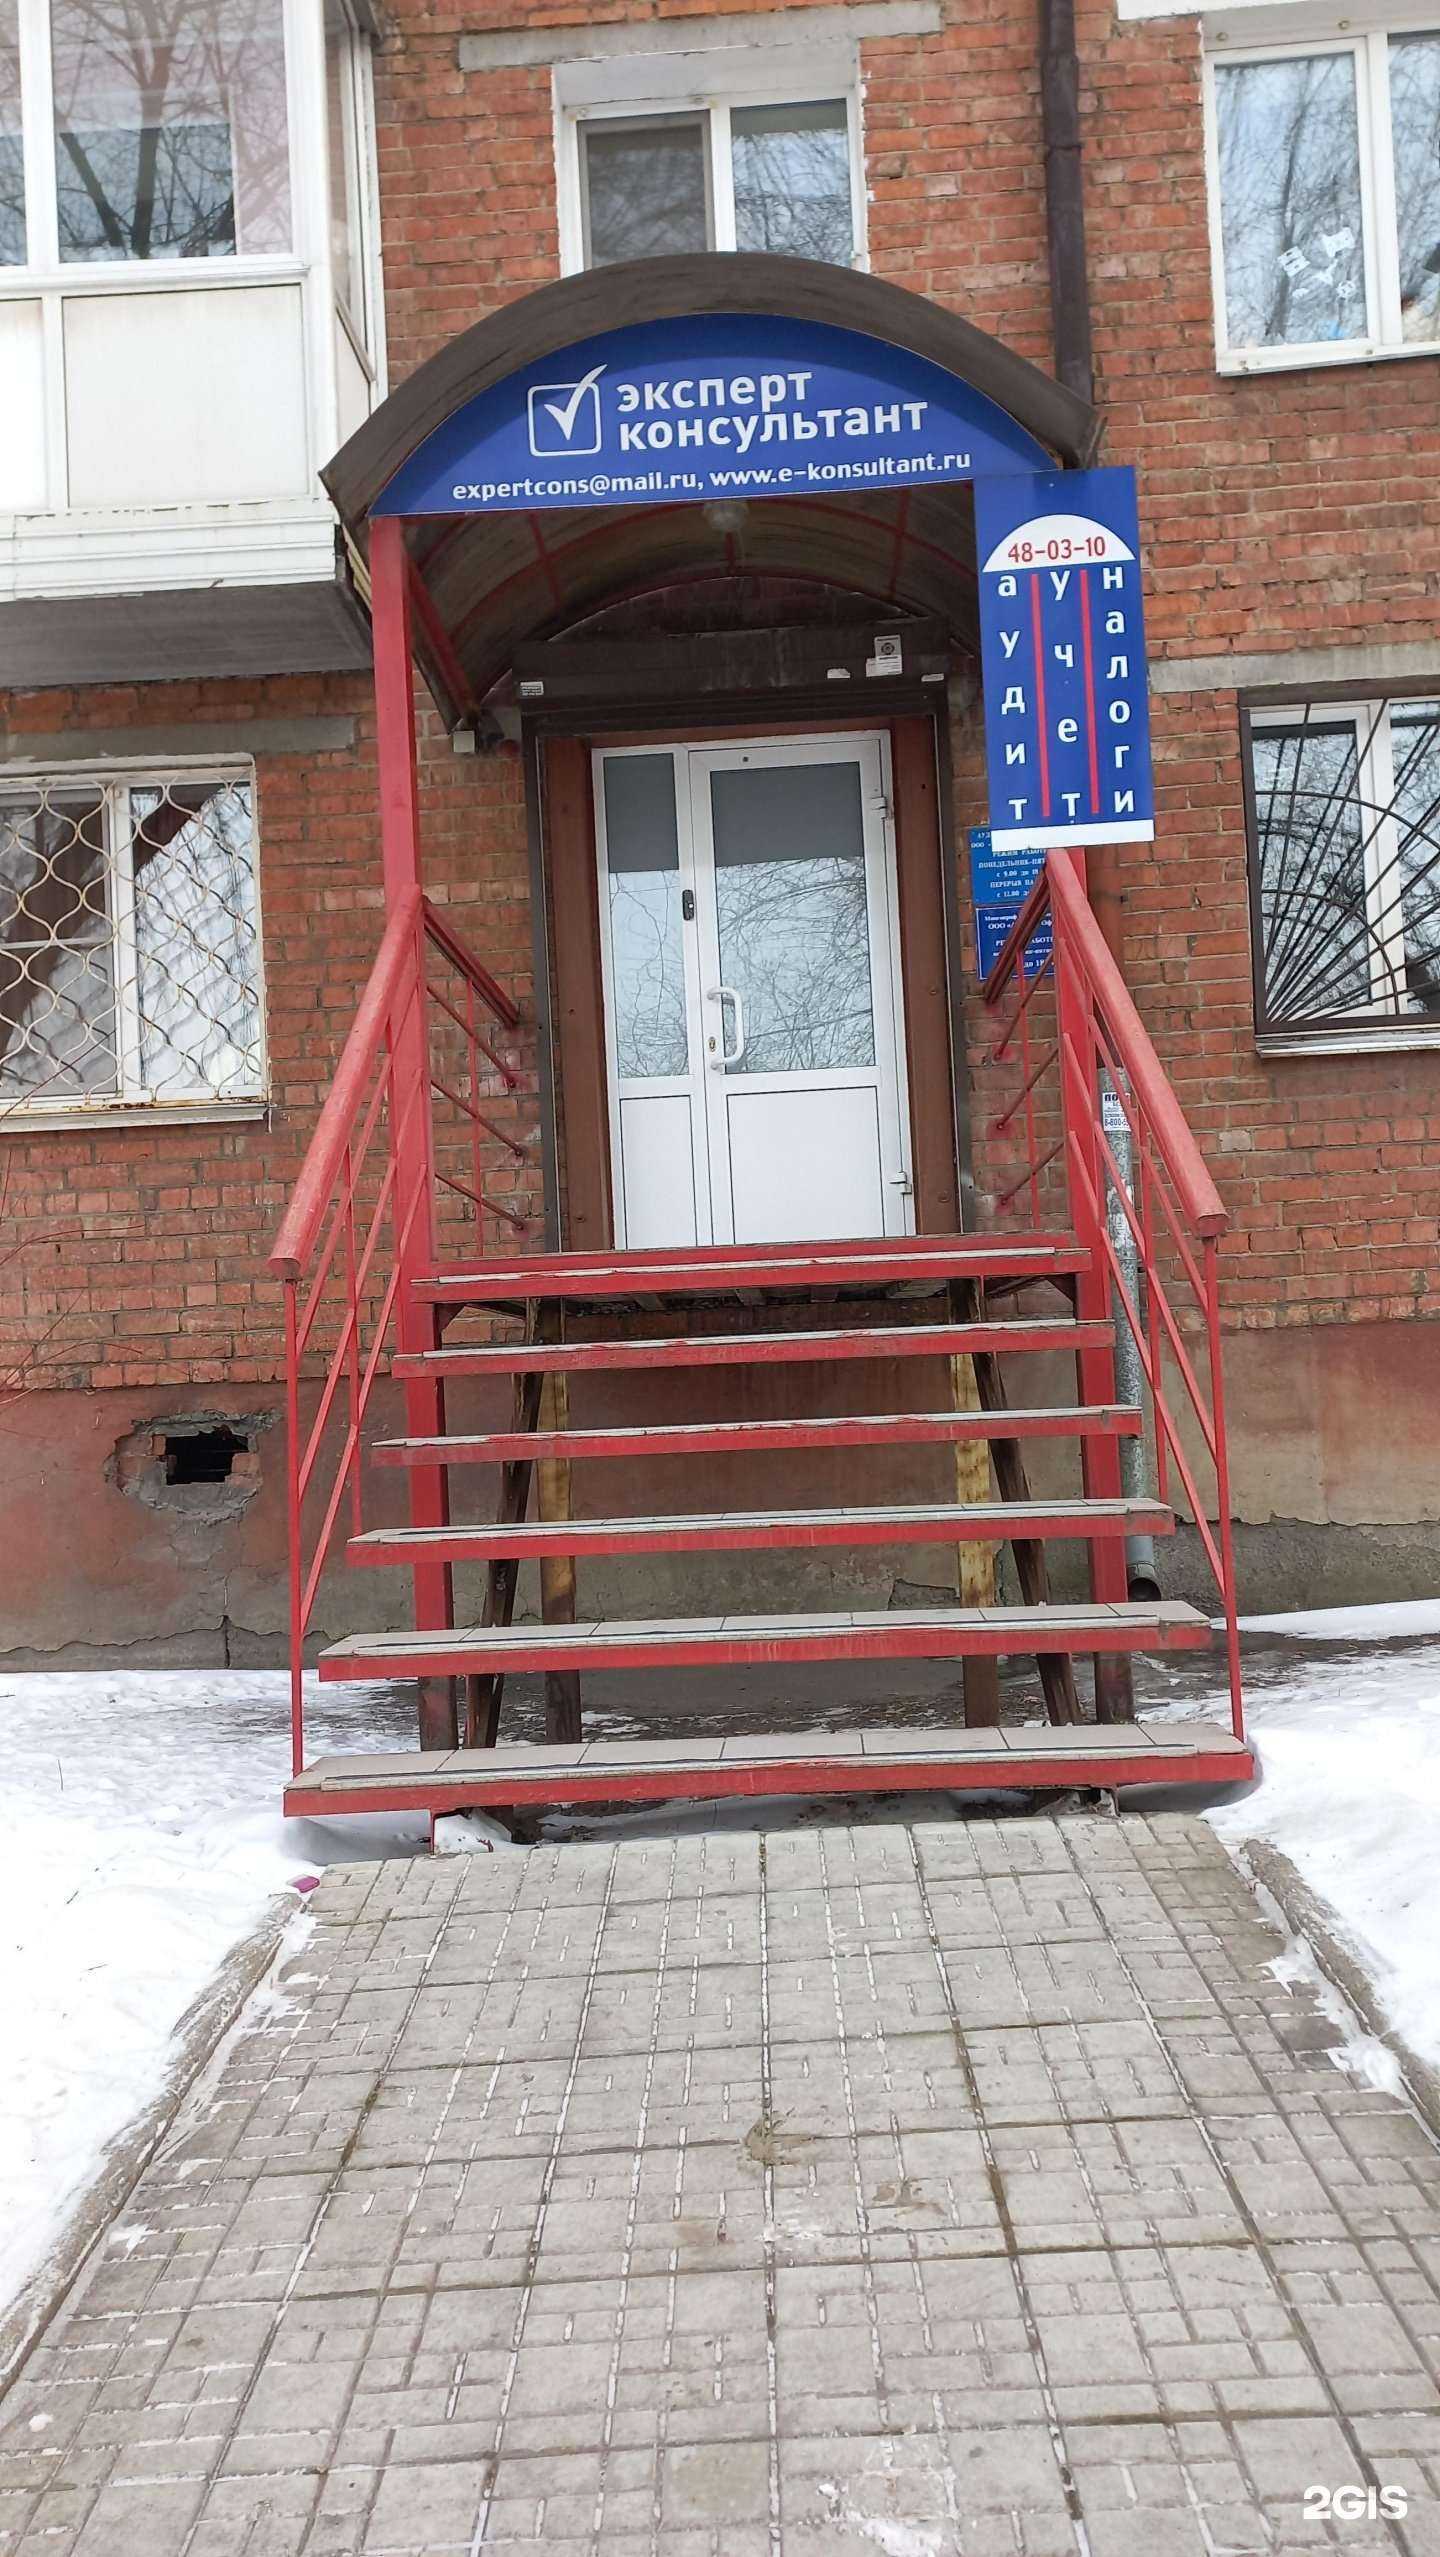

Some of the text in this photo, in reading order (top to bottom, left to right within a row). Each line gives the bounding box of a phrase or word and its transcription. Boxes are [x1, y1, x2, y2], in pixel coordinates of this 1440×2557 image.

[615, 371, 812, 415] эксперт
[619, 400, 928, 453] консультант
[452, 452, 971, 501] expertcons@mail.ru, www.e-konsultant.ru
[1008, 536, 1106, 563] 48-03-10
[998, 574, 1027, 820] аудит
[1050, 570, 1081, 816] учет
[1102, 566, 1135, 814] налоги
